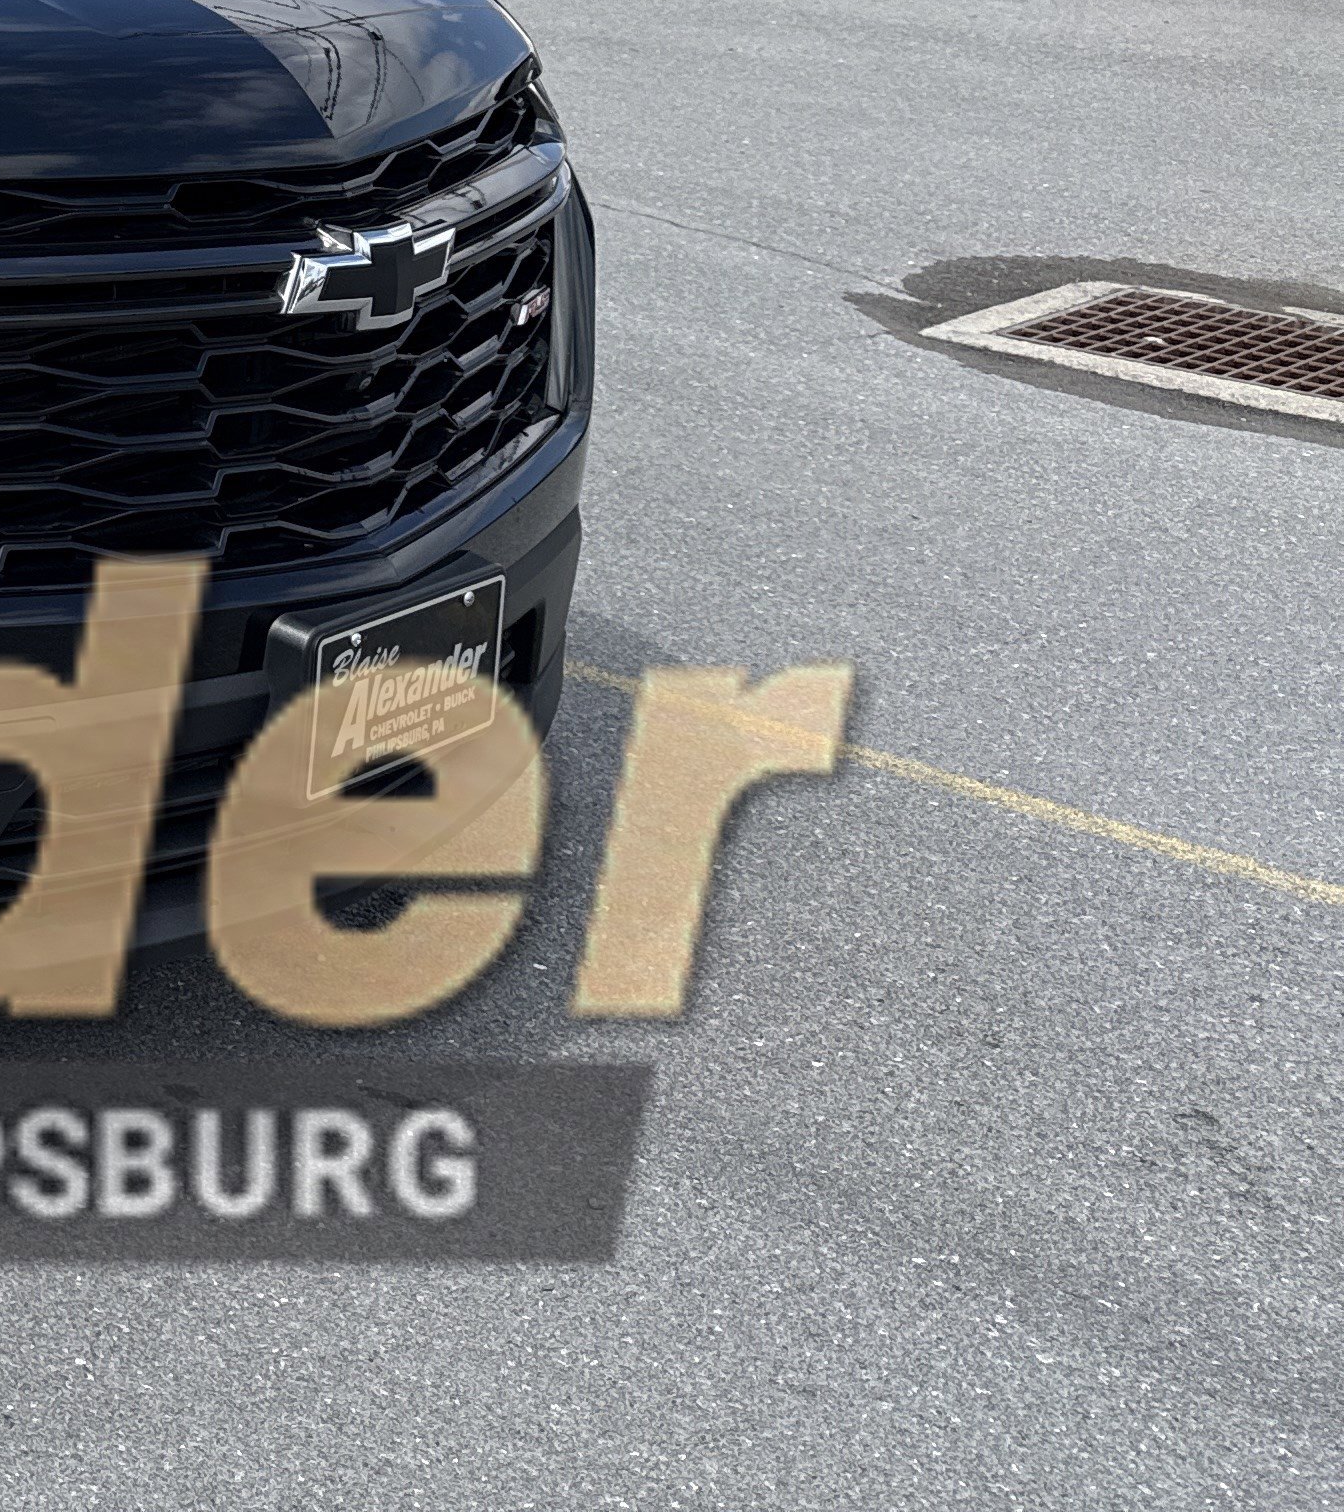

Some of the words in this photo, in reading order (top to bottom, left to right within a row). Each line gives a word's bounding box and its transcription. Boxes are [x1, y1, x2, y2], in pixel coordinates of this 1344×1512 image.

[332, 645, 400, 687] Blaise
[331, 642, 488, 759] Alexander
[369, 703, 434, 741] CHEVROLET
[443, 685, 476, 711] BUICK
[431, 717, 446, 736] PA
